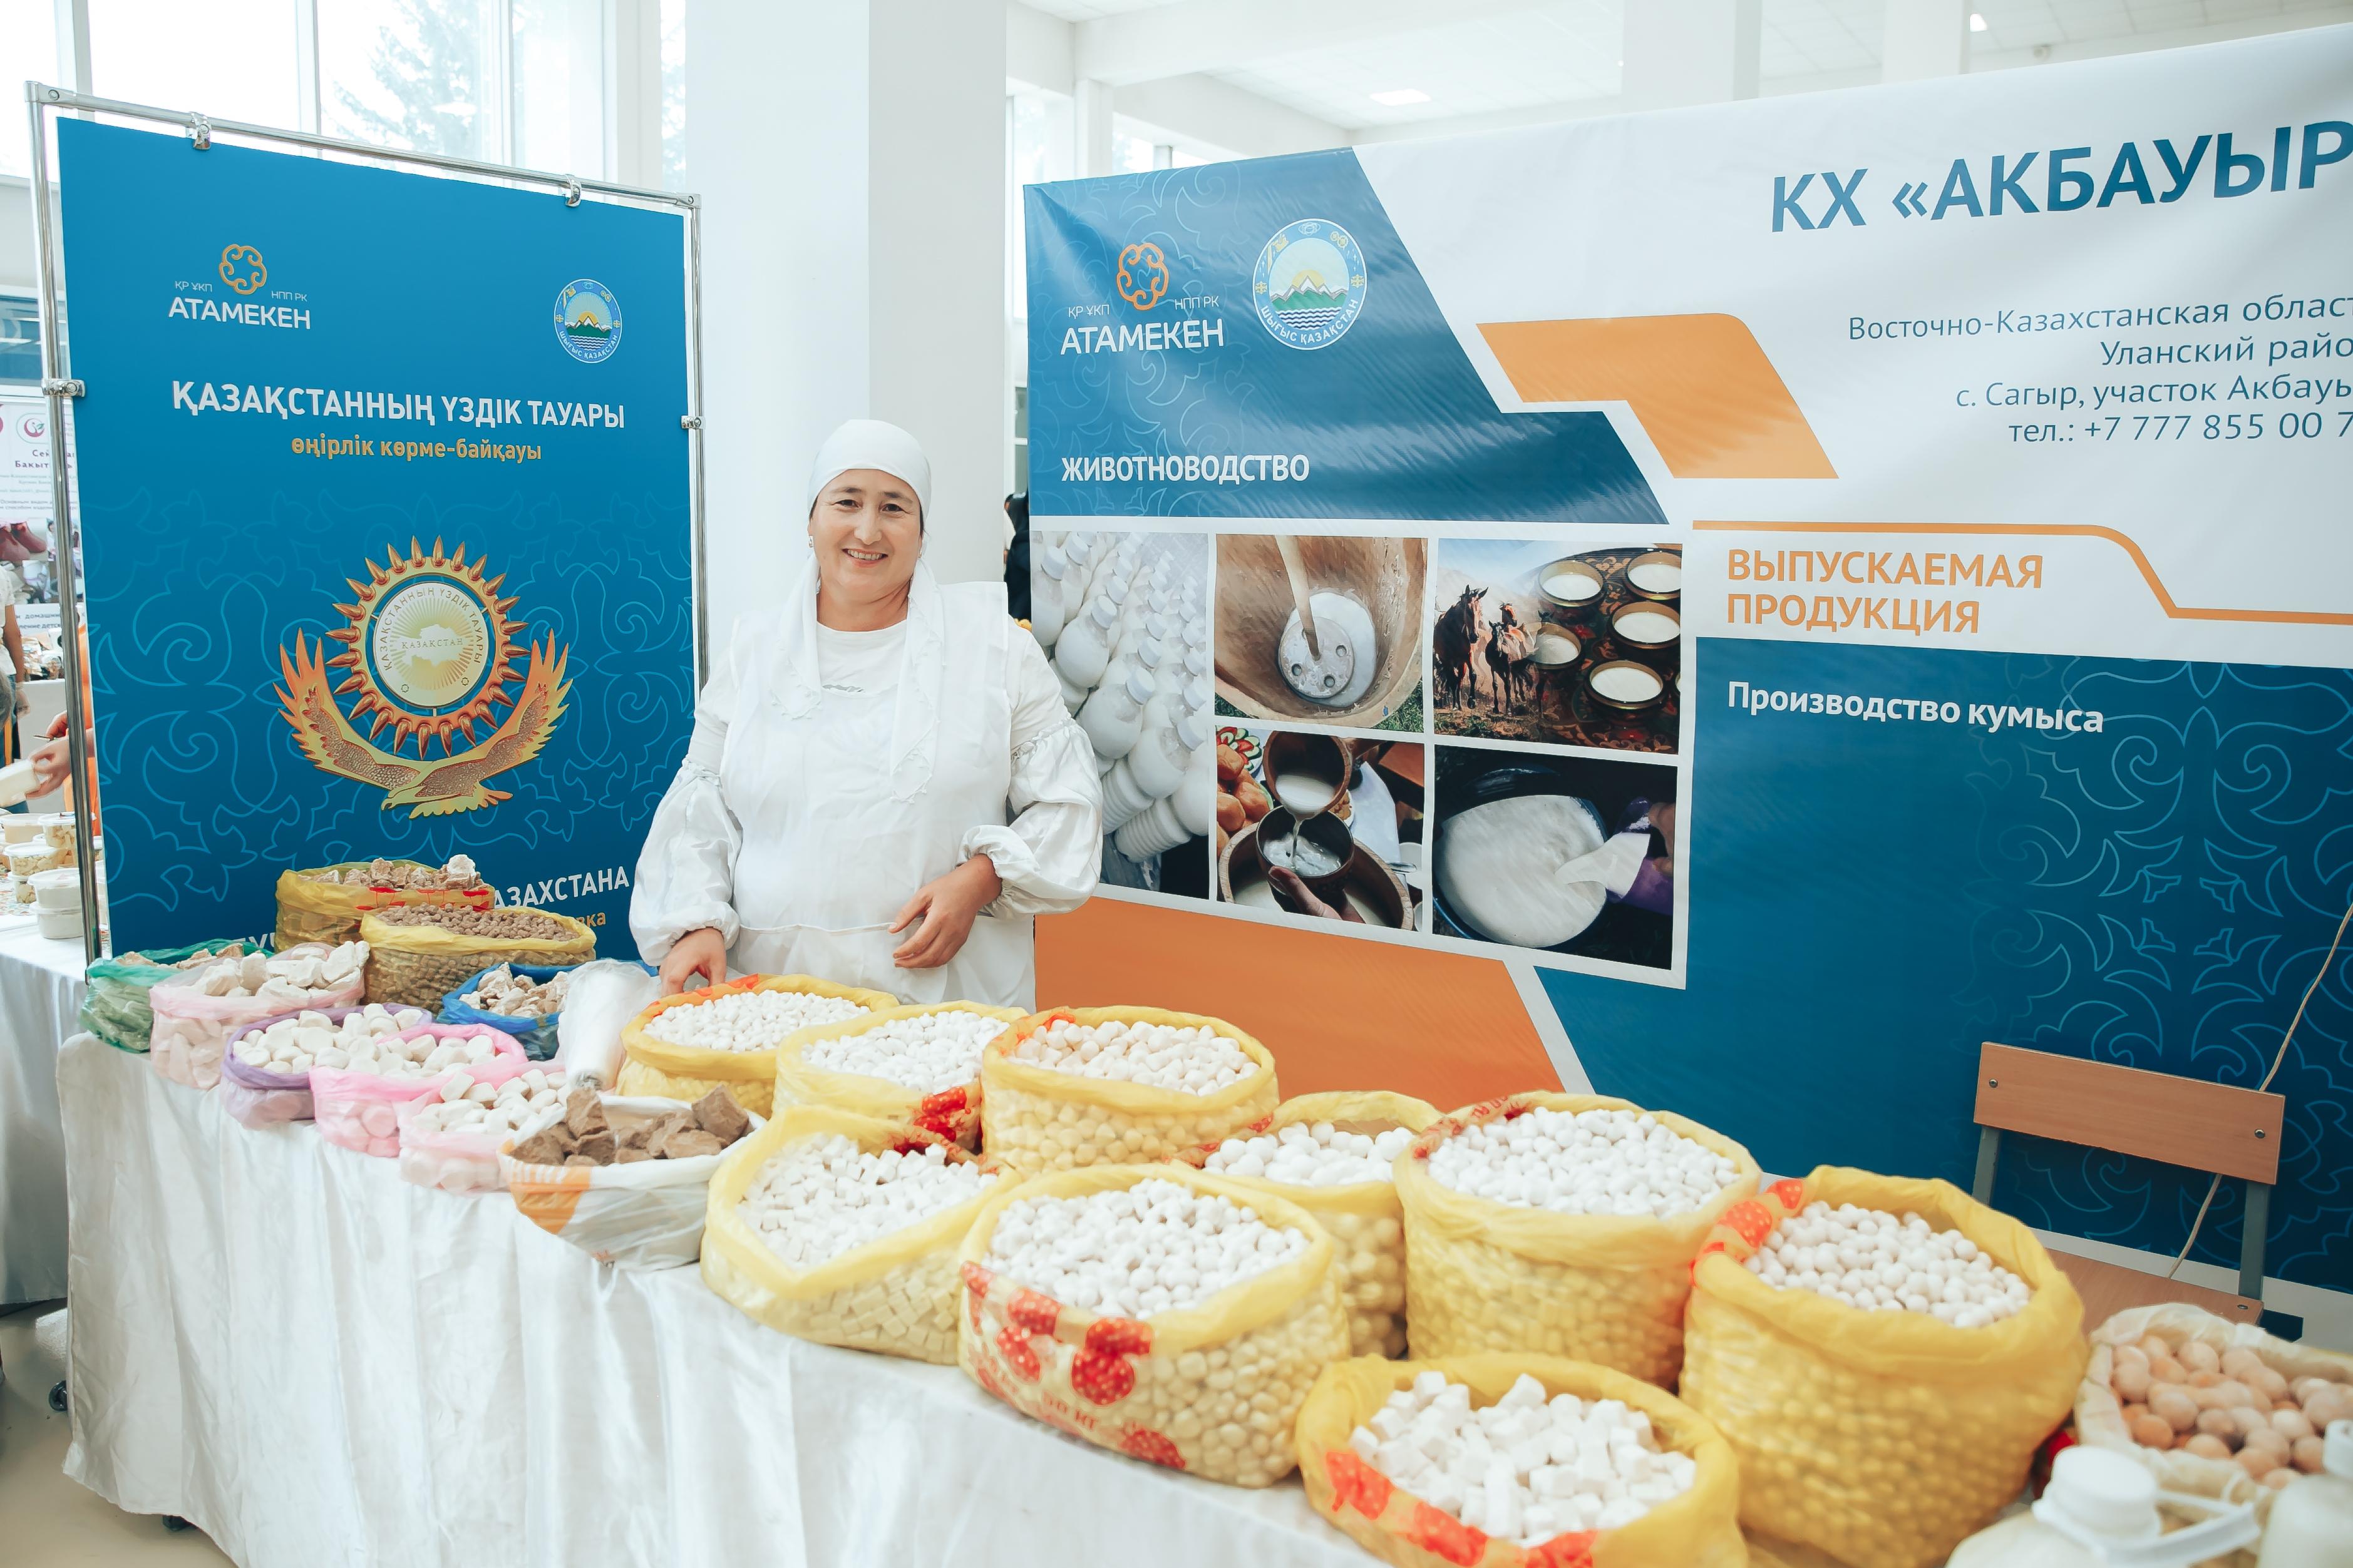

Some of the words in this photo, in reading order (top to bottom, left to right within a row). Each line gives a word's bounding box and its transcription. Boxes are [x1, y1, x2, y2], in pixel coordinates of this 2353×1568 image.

[1771, 168, 1869, 233] КХ
[175, 280, 190, 293] ҚР
[270, 290, 293, 301] НПП
[294, 292, 308, 302] РК
[1174, 297, 1201, 311] НПП
[1203, 295, 1220, 309] РК
[168, 295, 311, 331] АТАМЕКЕН
[1068, 305, 1084, 320] ҚР
[1299, 299, 1359, 344] ҚАЗАҚСТАН
[1849, 297, 2229, 340] Восточно-Казахстанская
[584, 335, 618, 359] ҚАЗАҚСТАН
[1060, 318, 1224, 355] АТАМЕКЕН
[2100, 336, 2255, 367] Уланский
[172, 381, 436, 427] ҚАЗАҚСТАННЫҢ
[441, 396, 523, 428] ҮЗДІК
[528, 401, 625, 429] ТАУАРЫ
[1956, 388, 1976, 407] с.
[1985, 381, 2085, 411] Сагыр,
[2093, 380, 2218, 411] участок
[2009, 421, 2076, 442] тел.:
[2084, 416, 2121, 441] +7
[2132, 416, 2191, 441] 777
[2203, 414, 2264, 439] 855
[2278, 411, 2322, 438] 00
[291, 433, 374, 461] өңірлік
[381, 438, 542, 464] көрме-байқауы
[1061, 453, 1310, 485] ЖИВОТНОВОДСТВО
[1727, 548, 2044, 589] ВЫПУСКАЕМАЯ
[1727, 593, 1980, 637] ПРОДУКЦИЯ
[1727, 680, 1960, 725] Производство
[1968, 702, 2104, 734] кумыса
[494, 866, 630, 910] АЗАХСТАНА
